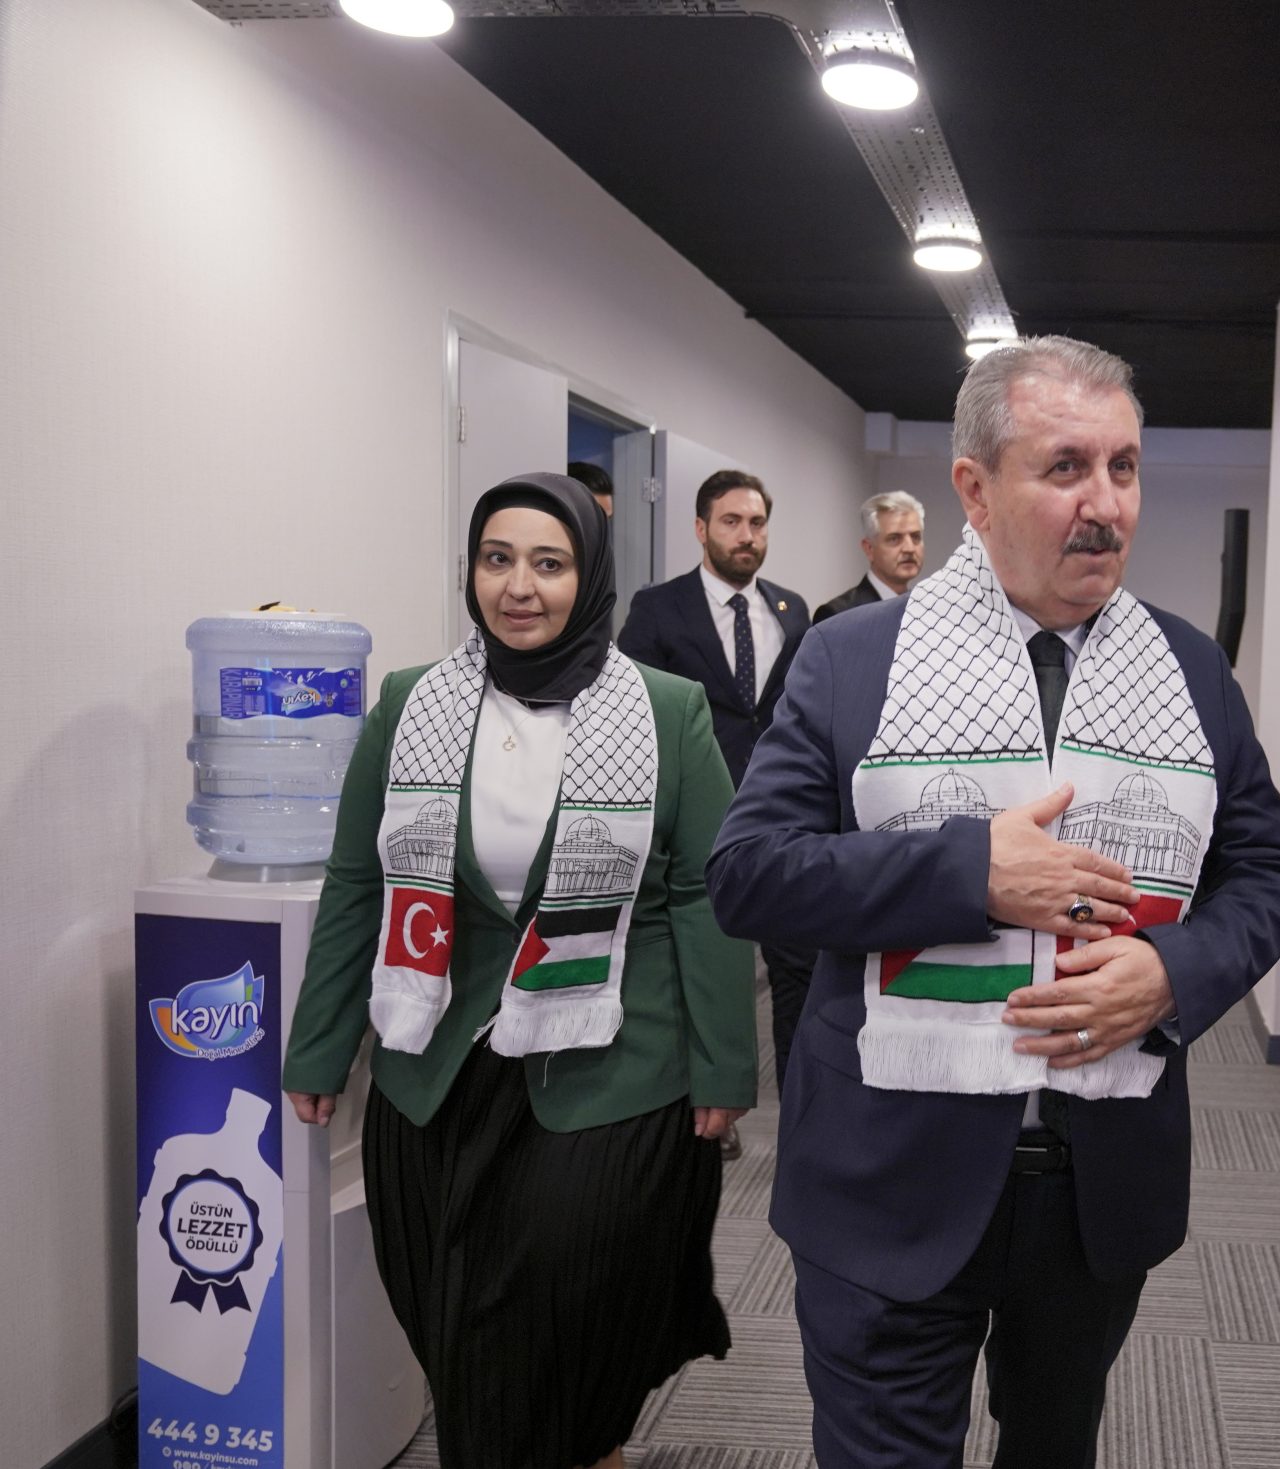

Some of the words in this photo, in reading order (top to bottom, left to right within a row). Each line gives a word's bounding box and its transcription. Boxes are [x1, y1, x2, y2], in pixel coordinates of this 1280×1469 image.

[171, 999, 259, 1040] kayın
[190, 1201, 233, 1218] ÜSTÜN
[177, 1218, 248, 1239] LEZZET
[186, 1236, 238, 1254] ÖDÜLLÜ
[147, 1418, 198, 1443] 444
[203, 1424, 220, 1445] 9
[225, 1427, 273, 1452] 345
[174, 1449, 258, 1467] www.kayinsu.com
